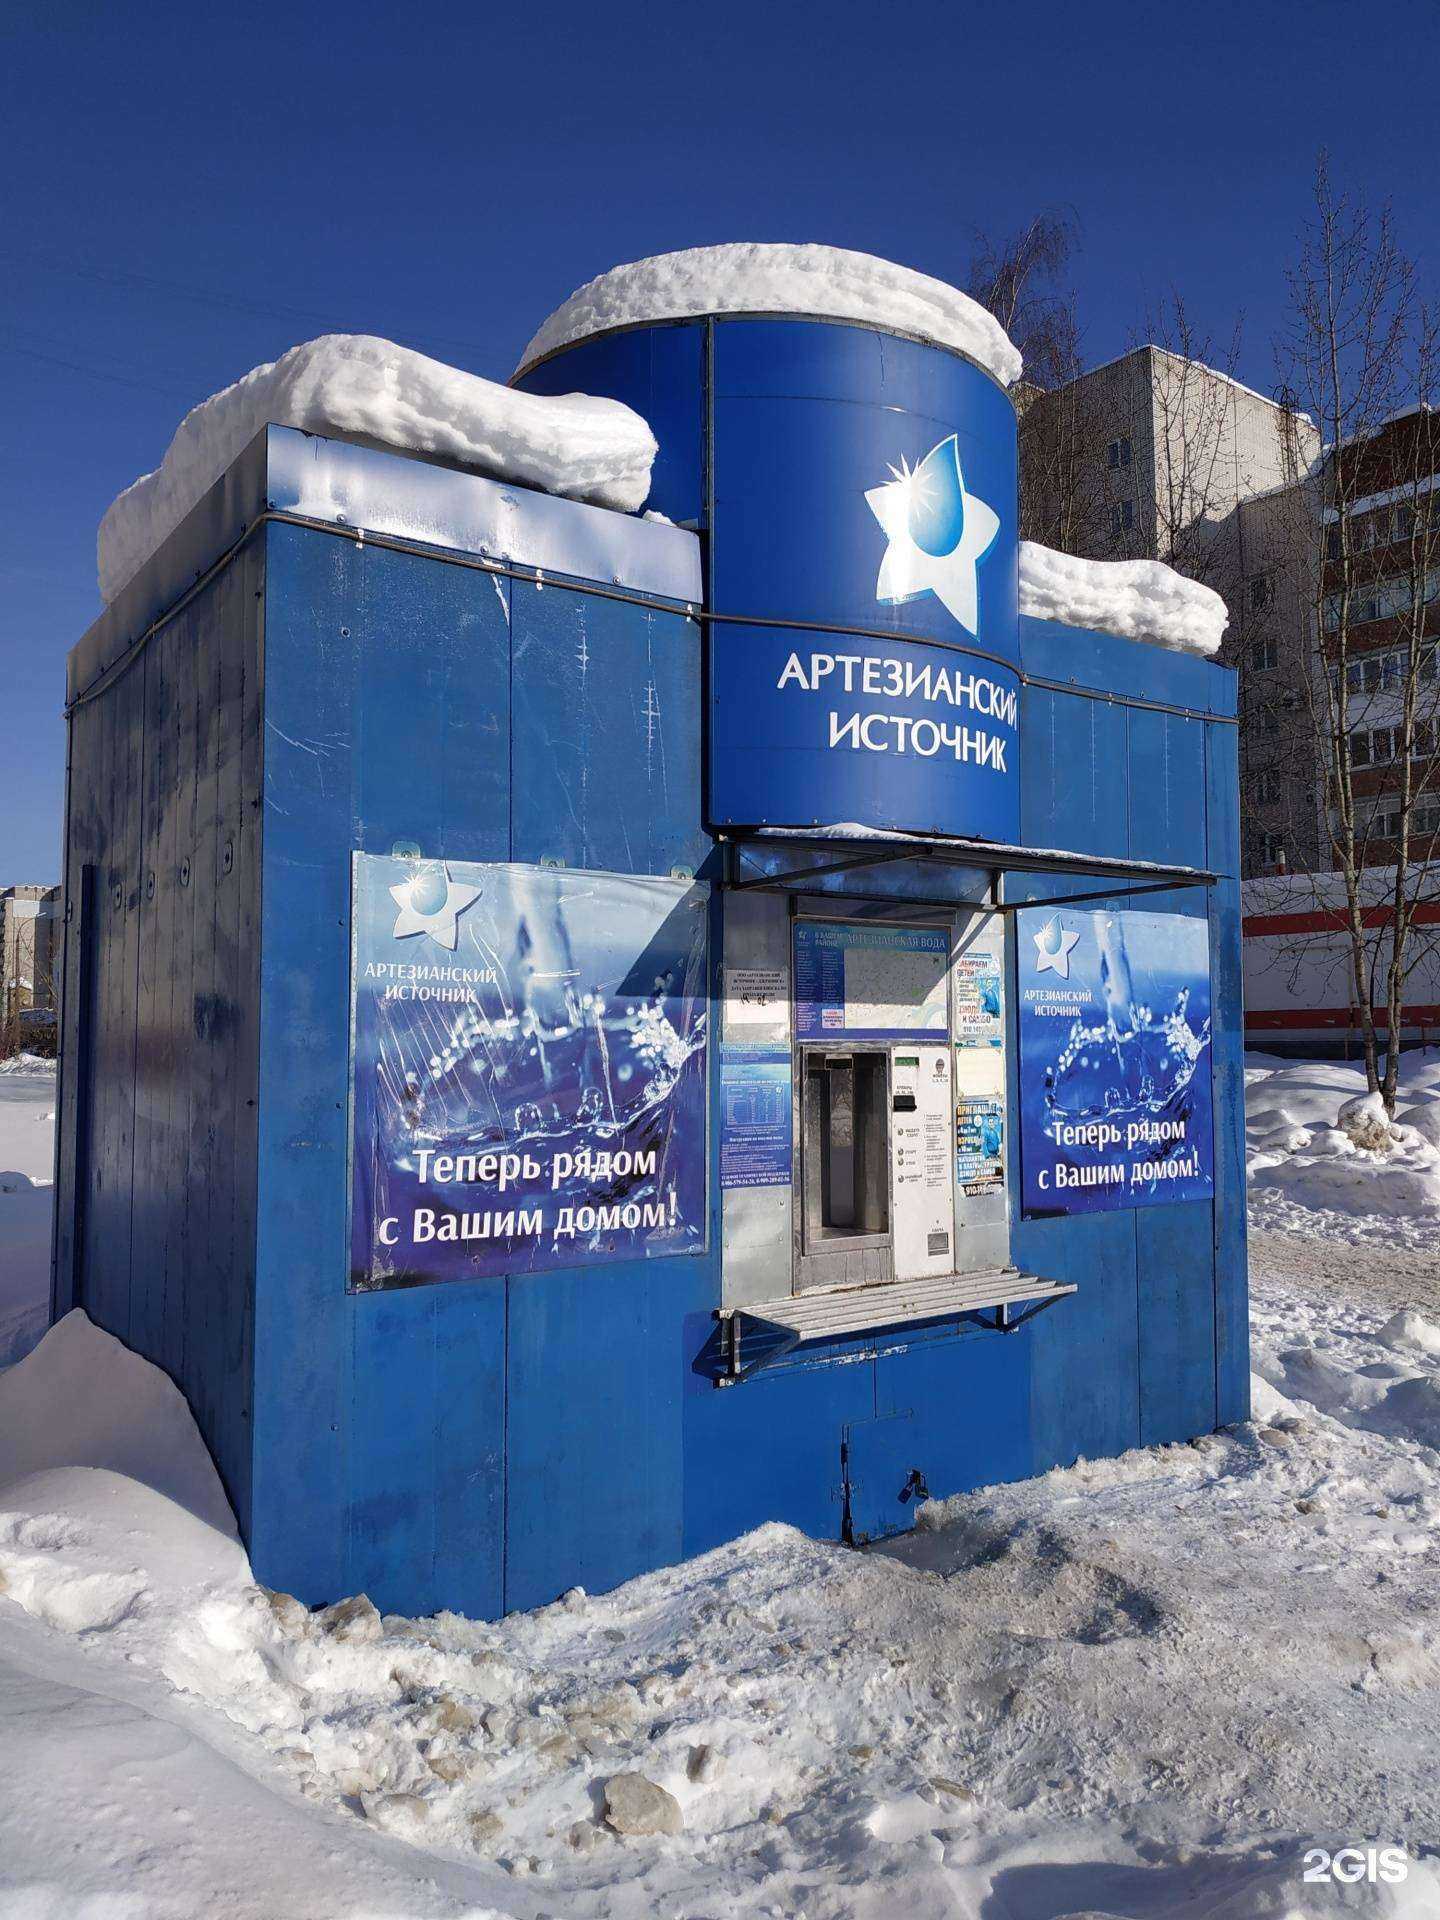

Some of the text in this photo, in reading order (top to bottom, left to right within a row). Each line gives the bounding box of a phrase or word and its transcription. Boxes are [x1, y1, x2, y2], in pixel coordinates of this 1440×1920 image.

[777, 652, 1017, 730] АРТЕЗИАНСКИЙ
[829, 711, 1007, 773] ИСТОЧНИК
[848, 933, 945, 950] АРТЕЗИАНСКАЯ ВОДА
[364, 962, 497, 984] АРТЕЗИАНСКИЙ
[385, 984, 478, 1004] ИСТОЧНИК
[1024, 988, 1092, 1003] АРТЕЗИАНСКИЙ
[1034, 1004, 1082, 1017] ИСТОЧНИК
[1052, 1119, 1185, 1152] Теперь рядом
[412, 1149, 656, 1191] Теперь рядом
[1038, 1151, 1199, 1189] с Вашим домом!
[379, 1192, 677, 1244] с Вашим домом!
